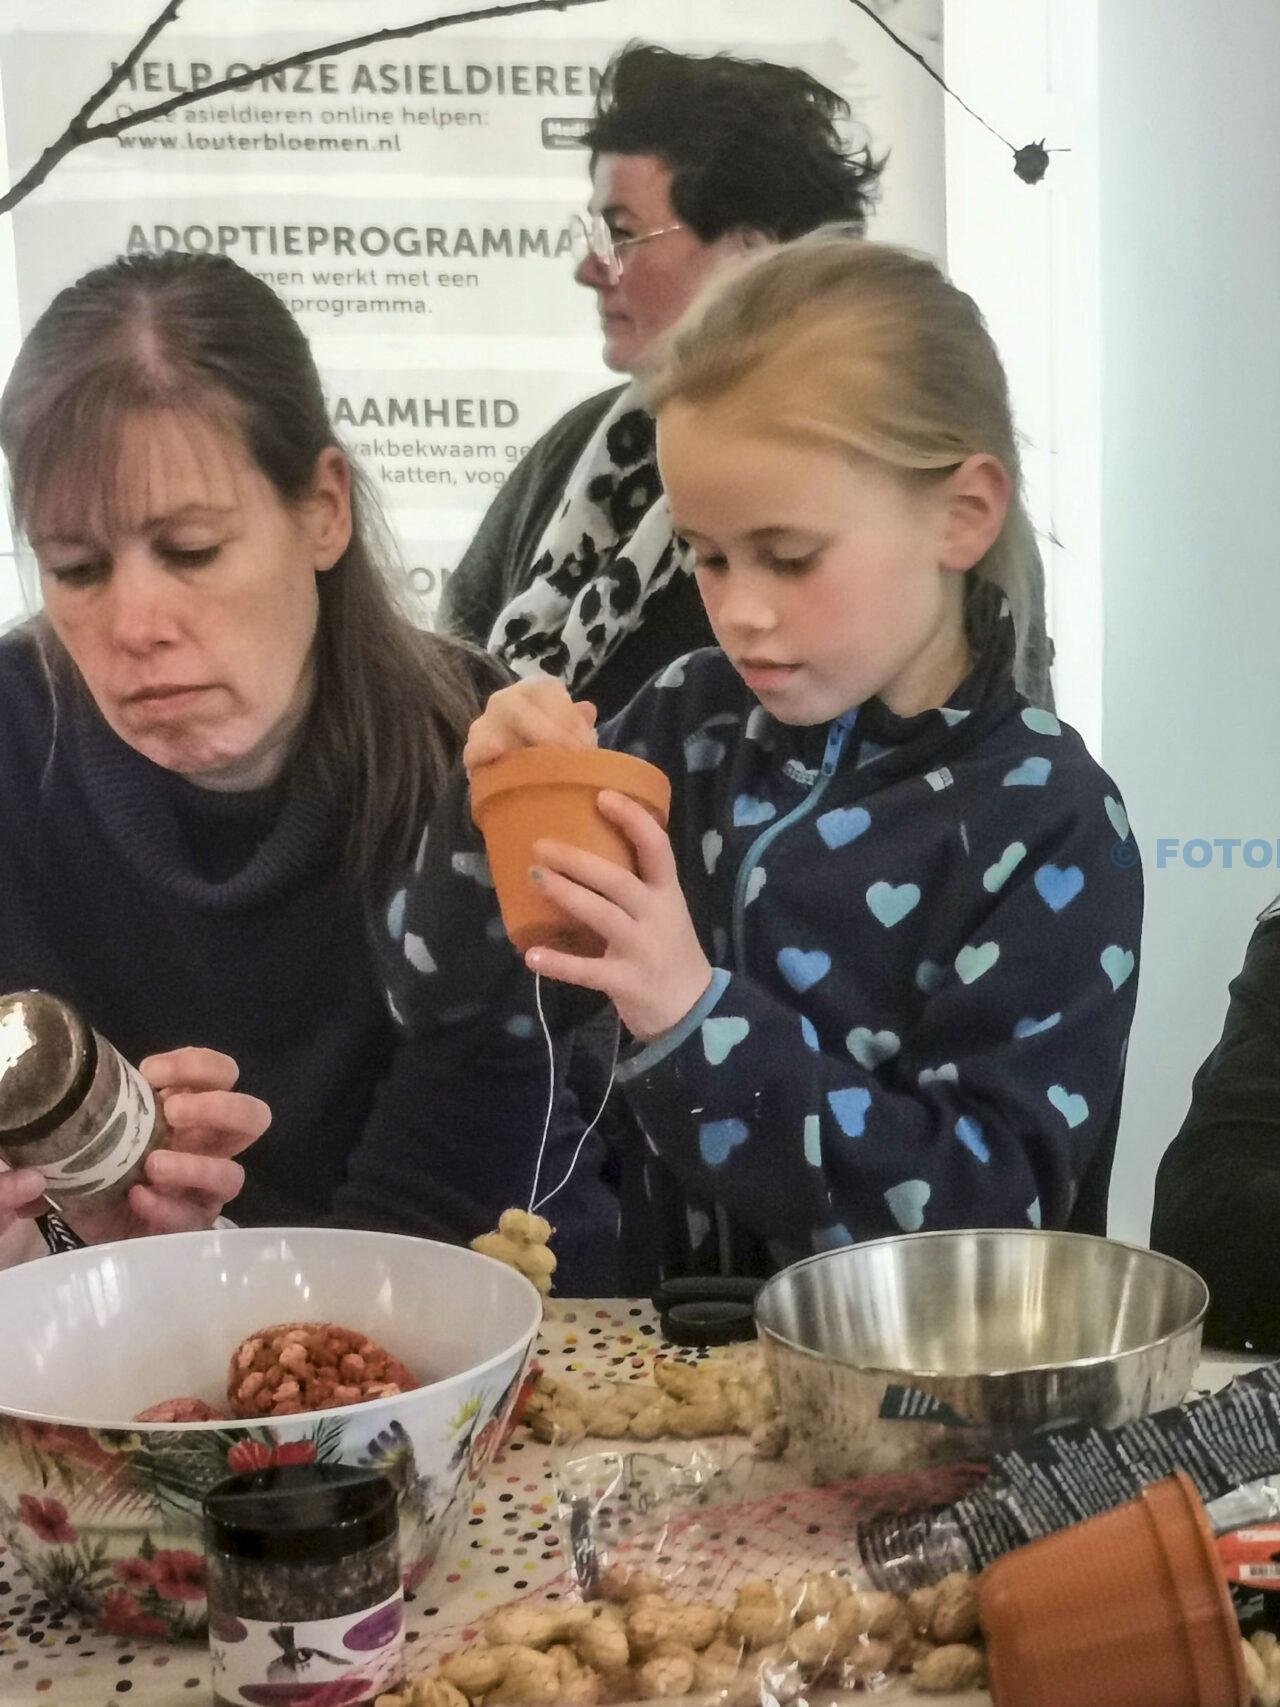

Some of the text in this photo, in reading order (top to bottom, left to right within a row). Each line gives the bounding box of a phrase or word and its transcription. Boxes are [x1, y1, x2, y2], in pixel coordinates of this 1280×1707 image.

[225, 62, 339, 94] ONZE
[185, 104, 313, 124] asieldieren
[321, 105, 393, 125] online
[402, 106, 490, 131] helpen:
[117, 132, 401, 152] www.louterbloemen.nl
[127, 224, 573, 258] ADOPTIEPROGRAMMA
[312, 268, 377, 287] werkt
[386, 269, 430, 288] met
[438, 273, 480, 288] een
[334, 396, 520, 428] AAMHEID
[381, 465, 457, 486] katten,
